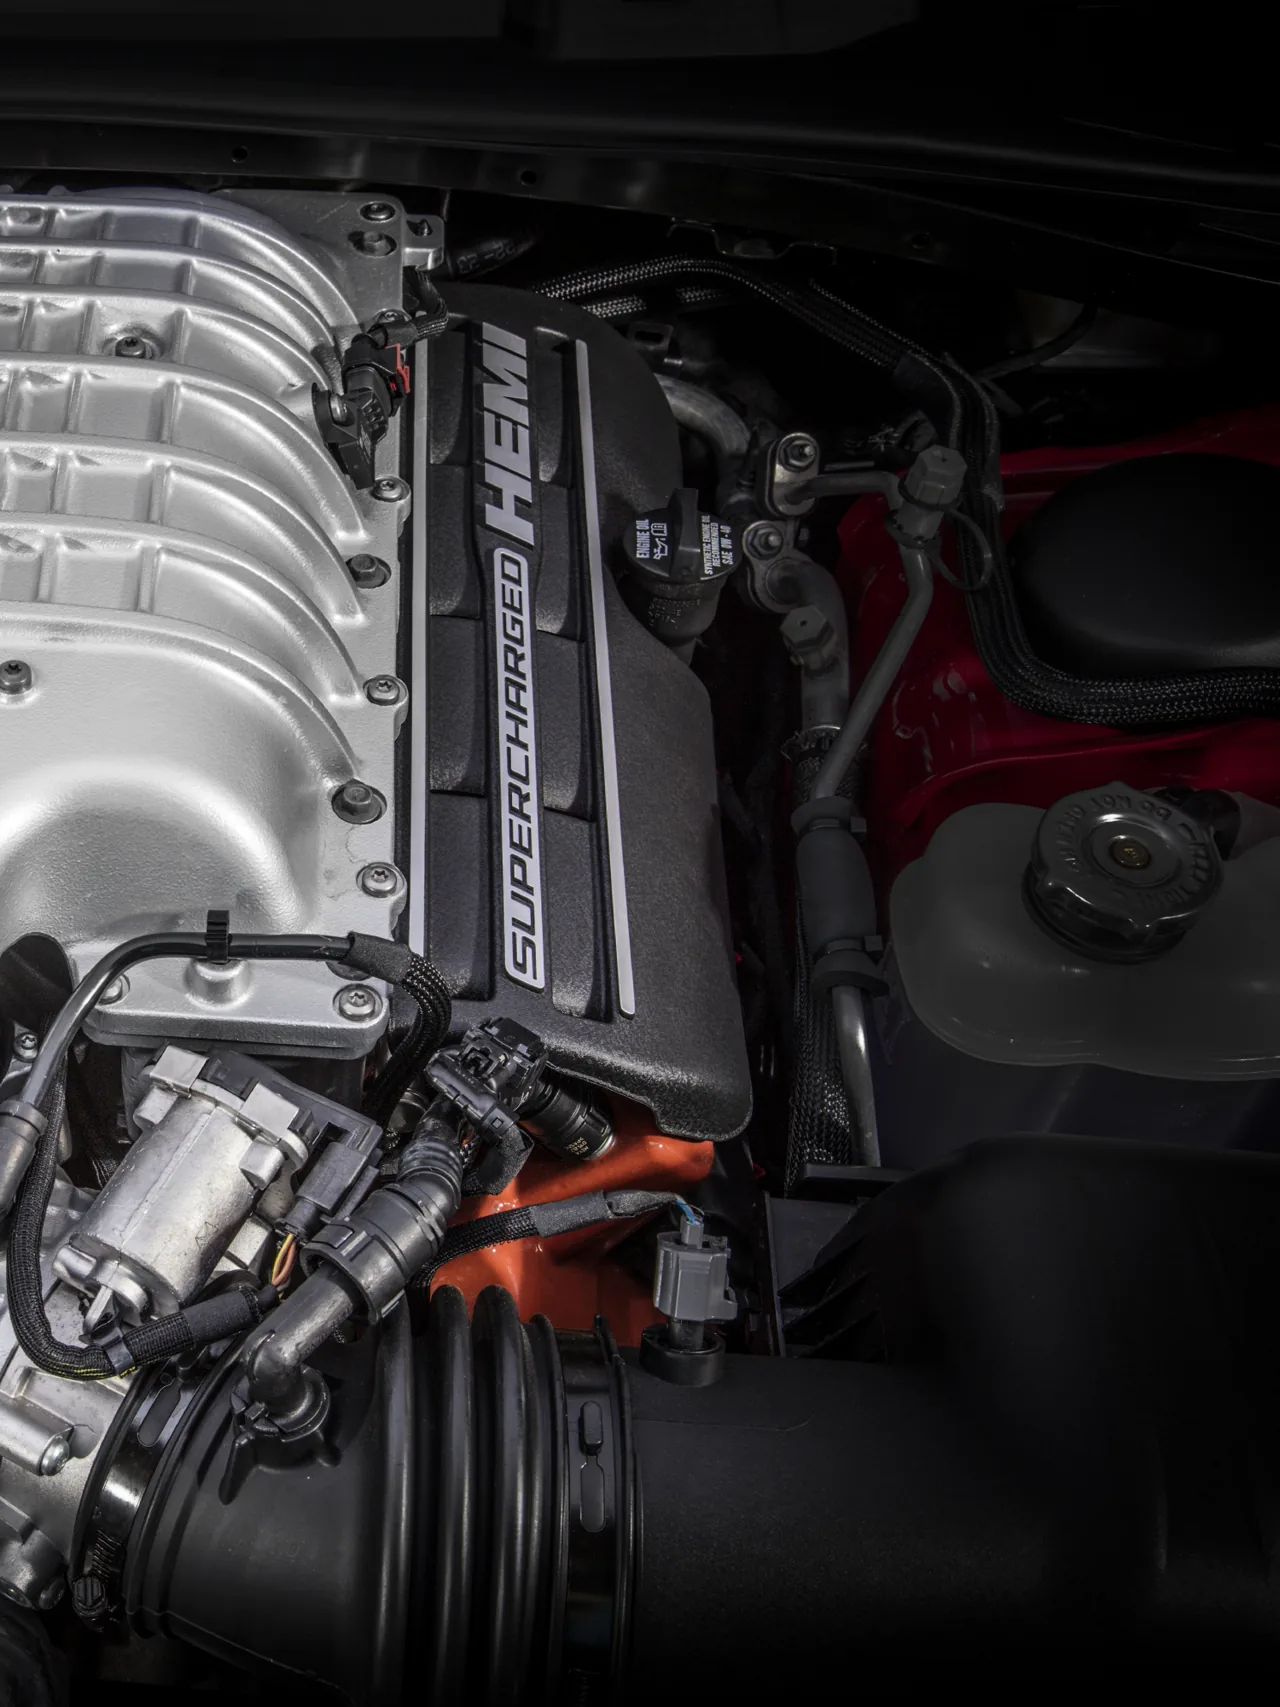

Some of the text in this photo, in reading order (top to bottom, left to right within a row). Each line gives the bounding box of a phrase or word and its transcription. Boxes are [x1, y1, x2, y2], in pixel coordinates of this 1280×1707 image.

[635, 519, 650, 559] ENGINE OIL
[701, 515, 714, 575] SYNTHETIC ENGINE OIL
[710, 522, 721, 567] RECOMMENDED
[721, 551, 734, 565] SAE
[482, 321, 538, 981] SUPERCHARGED HEMI
